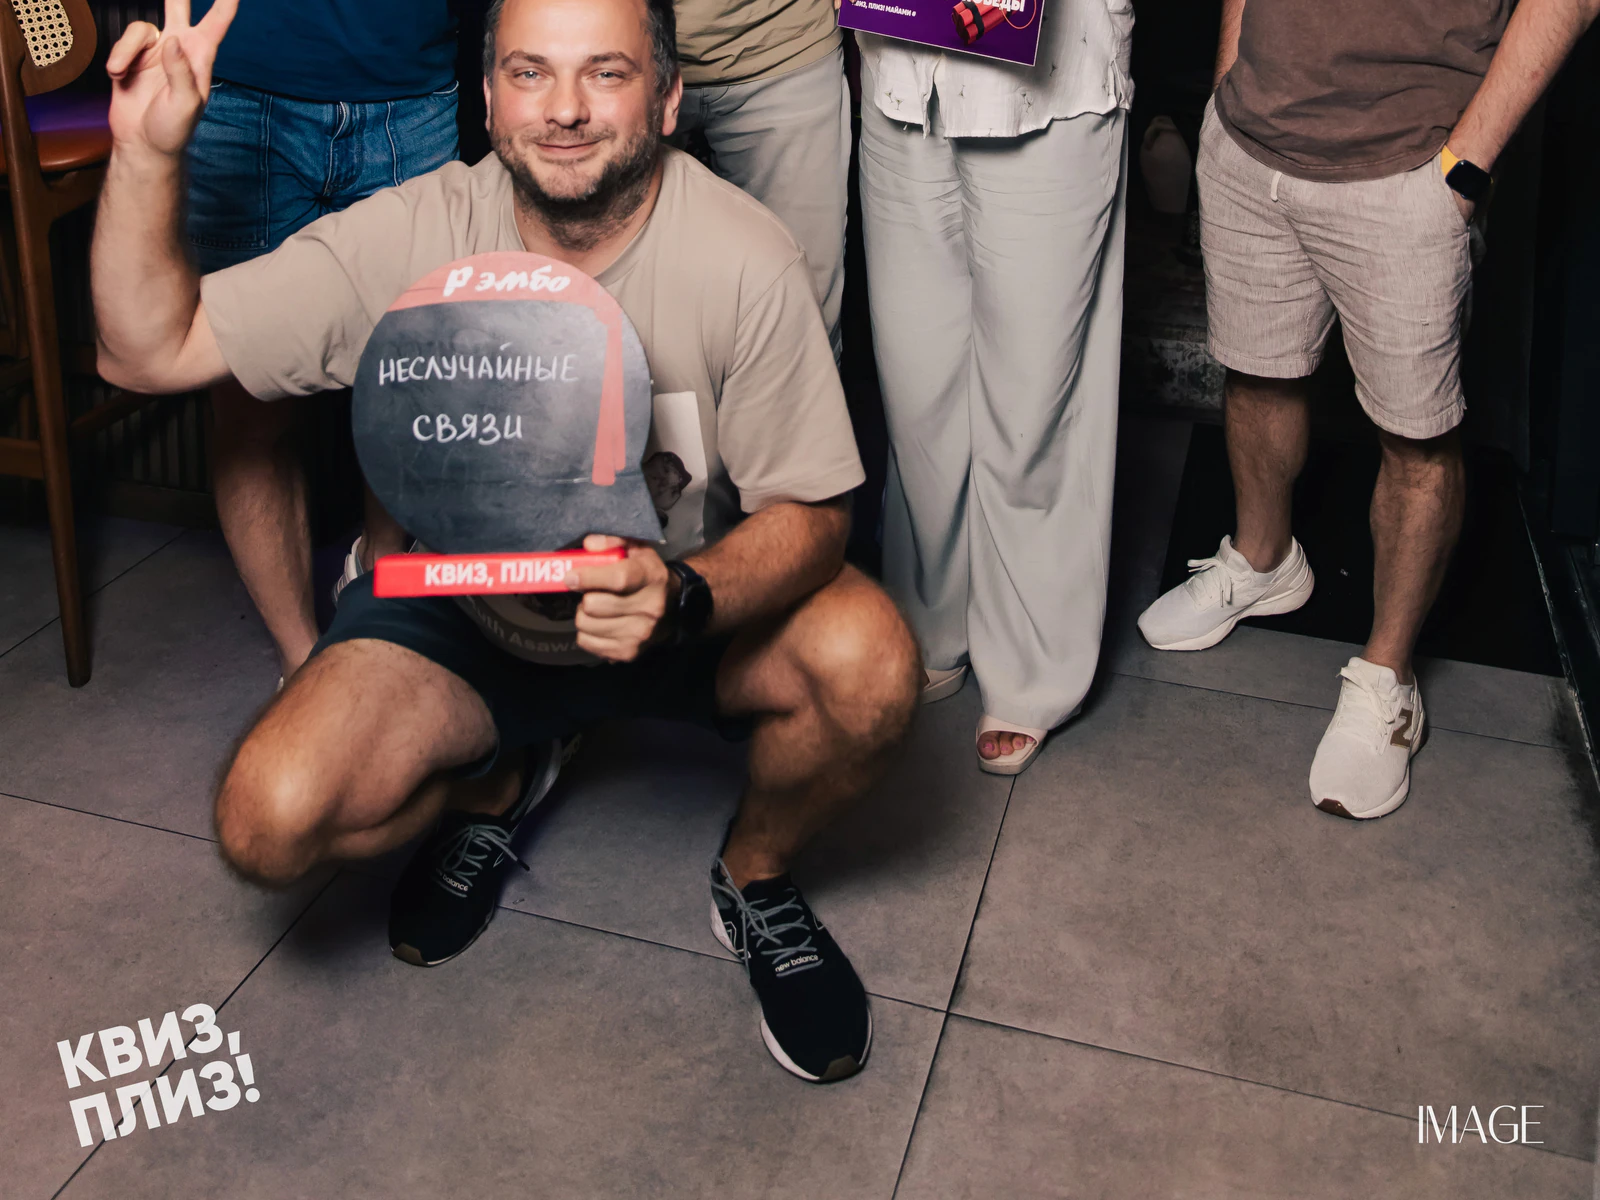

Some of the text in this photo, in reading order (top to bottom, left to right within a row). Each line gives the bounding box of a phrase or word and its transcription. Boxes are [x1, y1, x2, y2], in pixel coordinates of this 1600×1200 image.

[885, 6, 912, 16] МАЙАМИ
[442, 264, 572, 297] Рэмбо
[378, 342, 580, 386] НЕСЛУЧАЙНЫЕ
[412, 413, 524, 446] СВЯЗИ
[424, 561, 494, 587] КВИЗ,
[775, 954, 819, 973] new balance
